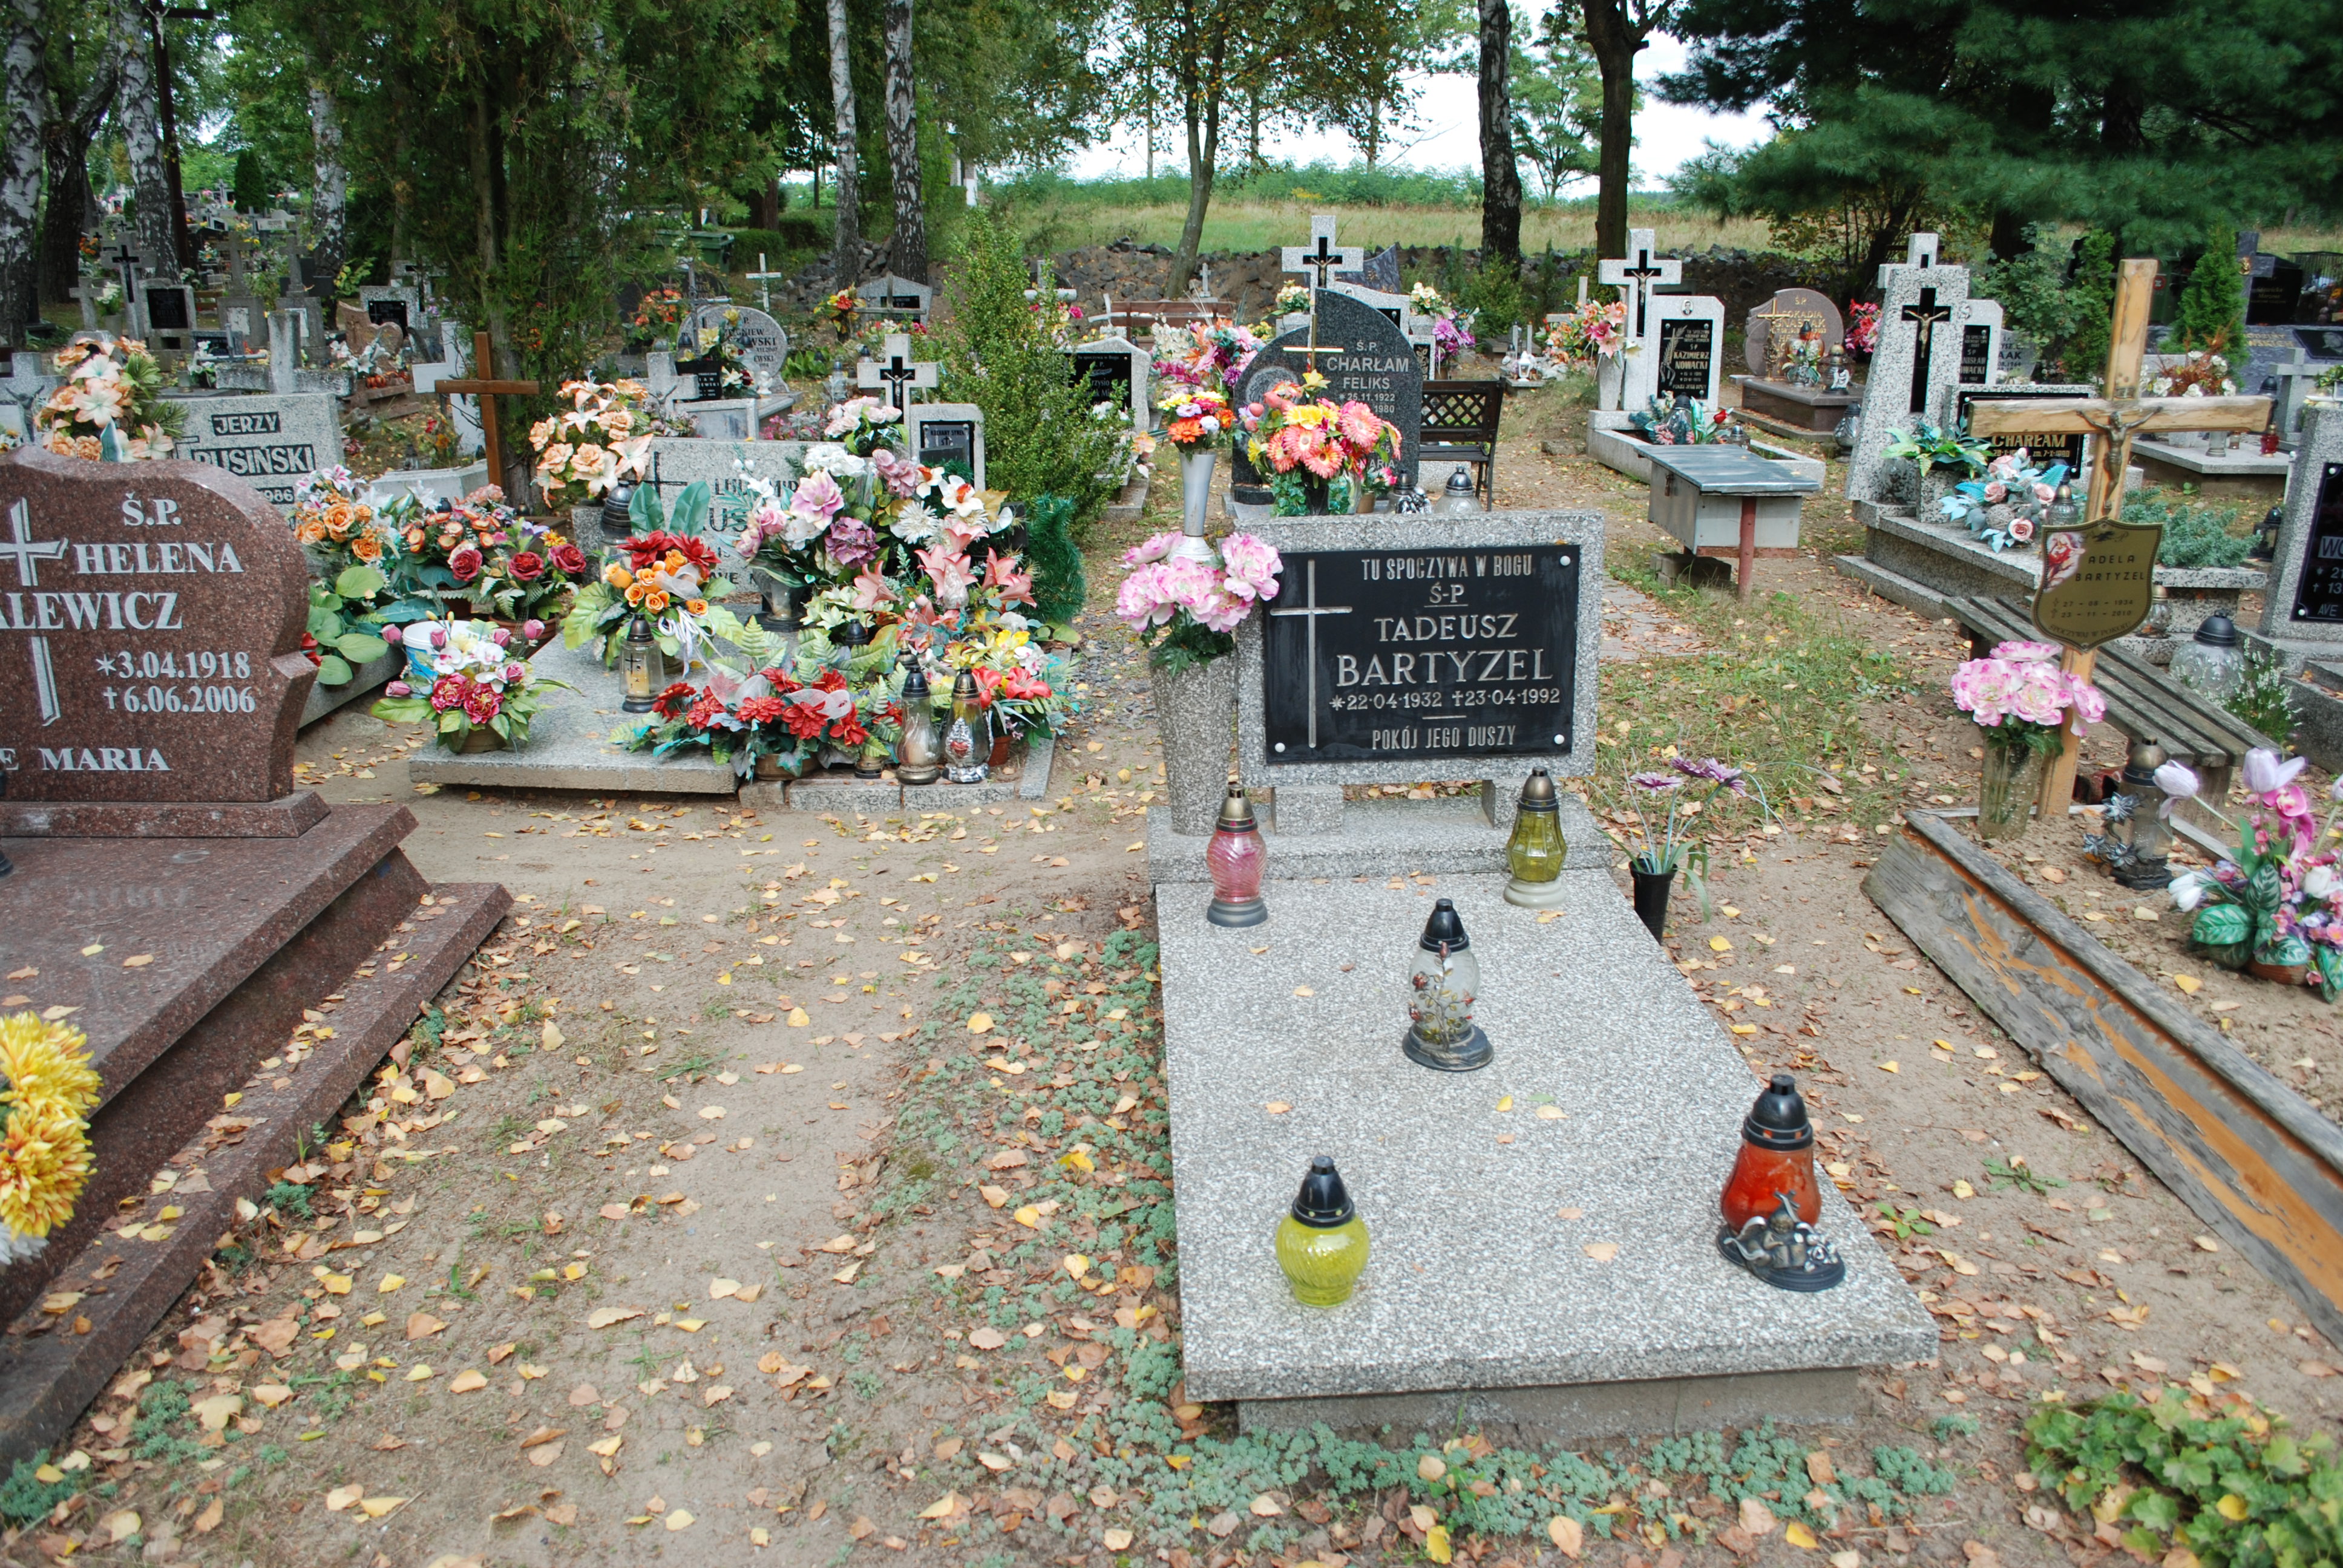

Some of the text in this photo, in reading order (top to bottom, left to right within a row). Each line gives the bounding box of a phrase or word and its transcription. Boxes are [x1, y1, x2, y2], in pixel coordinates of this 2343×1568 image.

[1326, 357, 1409, 373] CHARŁAM
[1675, 361, 1708, 370] NOWACKI
[1343, 377, 1391, 390] FELIKS
[214, 415, 278, 434] JERZY
[1991, 434, 2067, 448] CHARŁAM
[76, 543, 243, 574] HELENA
[1362, 554, 1532, 580] TU SPOCZYWA W BOGU
[2088, 555, 2135, 564] ADELA
[2075, 572, 2145, 582] BARTYZEL
[2317, 604, 2339, 617] AVE
[1374, 613, 1519, 642] TADEUSZ
[1336, 648, 1554, 687] BARTYZEL
[1371, 724, 1516, 751] POKÓJ JEGO DUSZY
[38, 748, 171, 771] MARIA
